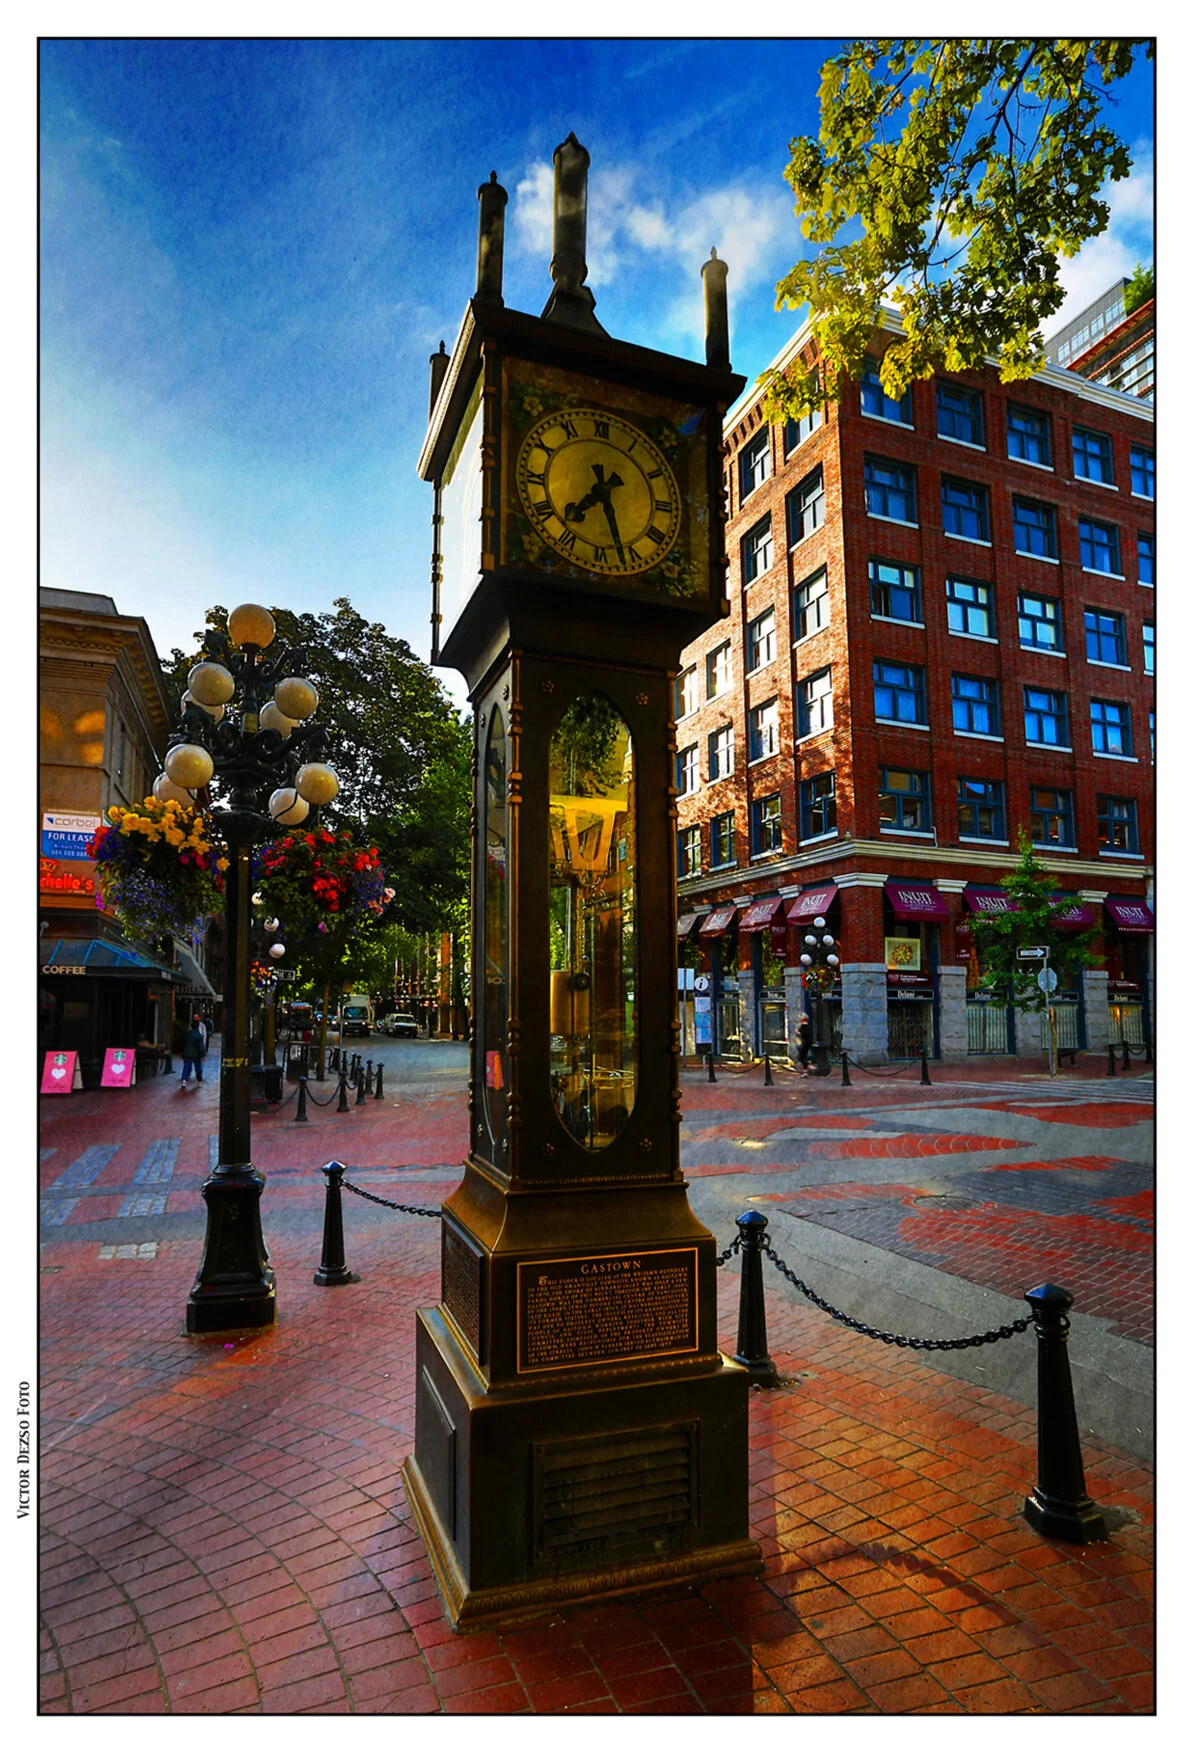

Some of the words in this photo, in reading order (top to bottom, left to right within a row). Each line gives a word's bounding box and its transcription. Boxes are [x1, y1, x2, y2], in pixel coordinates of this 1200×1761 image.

[55, 817, 96, 827] corbel
[48, 832, 65, 841] FOR
[67, 833, 95, 843] LEASE
[897, 891, 933, 903] INUIT
[975, 897, 1010, 909] INUIT
[42, 965, 87, 975] COFFEE
[581, 1260, 641, 1274] GASTOWN
